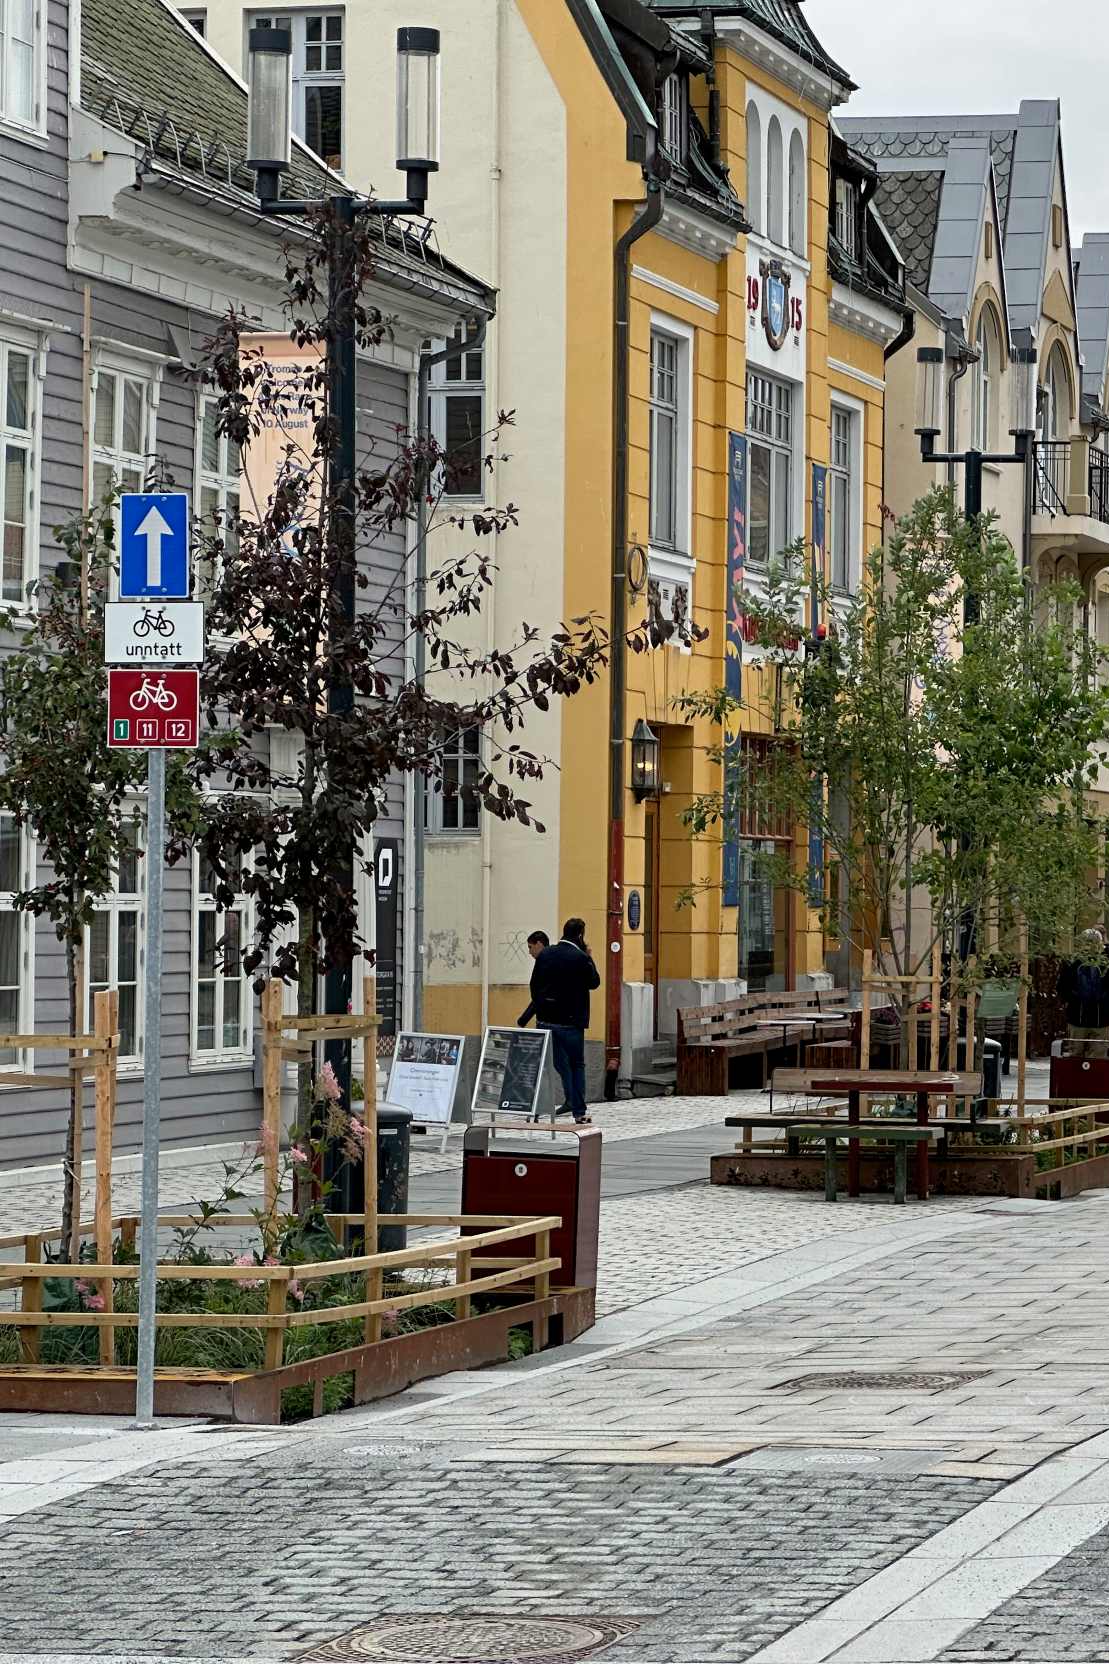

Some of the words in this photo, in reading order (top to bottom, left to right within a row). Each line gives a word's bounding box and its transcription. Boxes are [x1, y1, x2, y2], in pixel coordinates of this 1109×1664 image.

[747, 275, 759, 311] 19
[791, 296, 803, 331] 15
[275, 419, 308, 430] August
[126, 643, 182, 656] unntatt
[119, 723, 125, 737] 1
[142, 723, 152, 737] 11
[171, 723, 186, 737] 12
